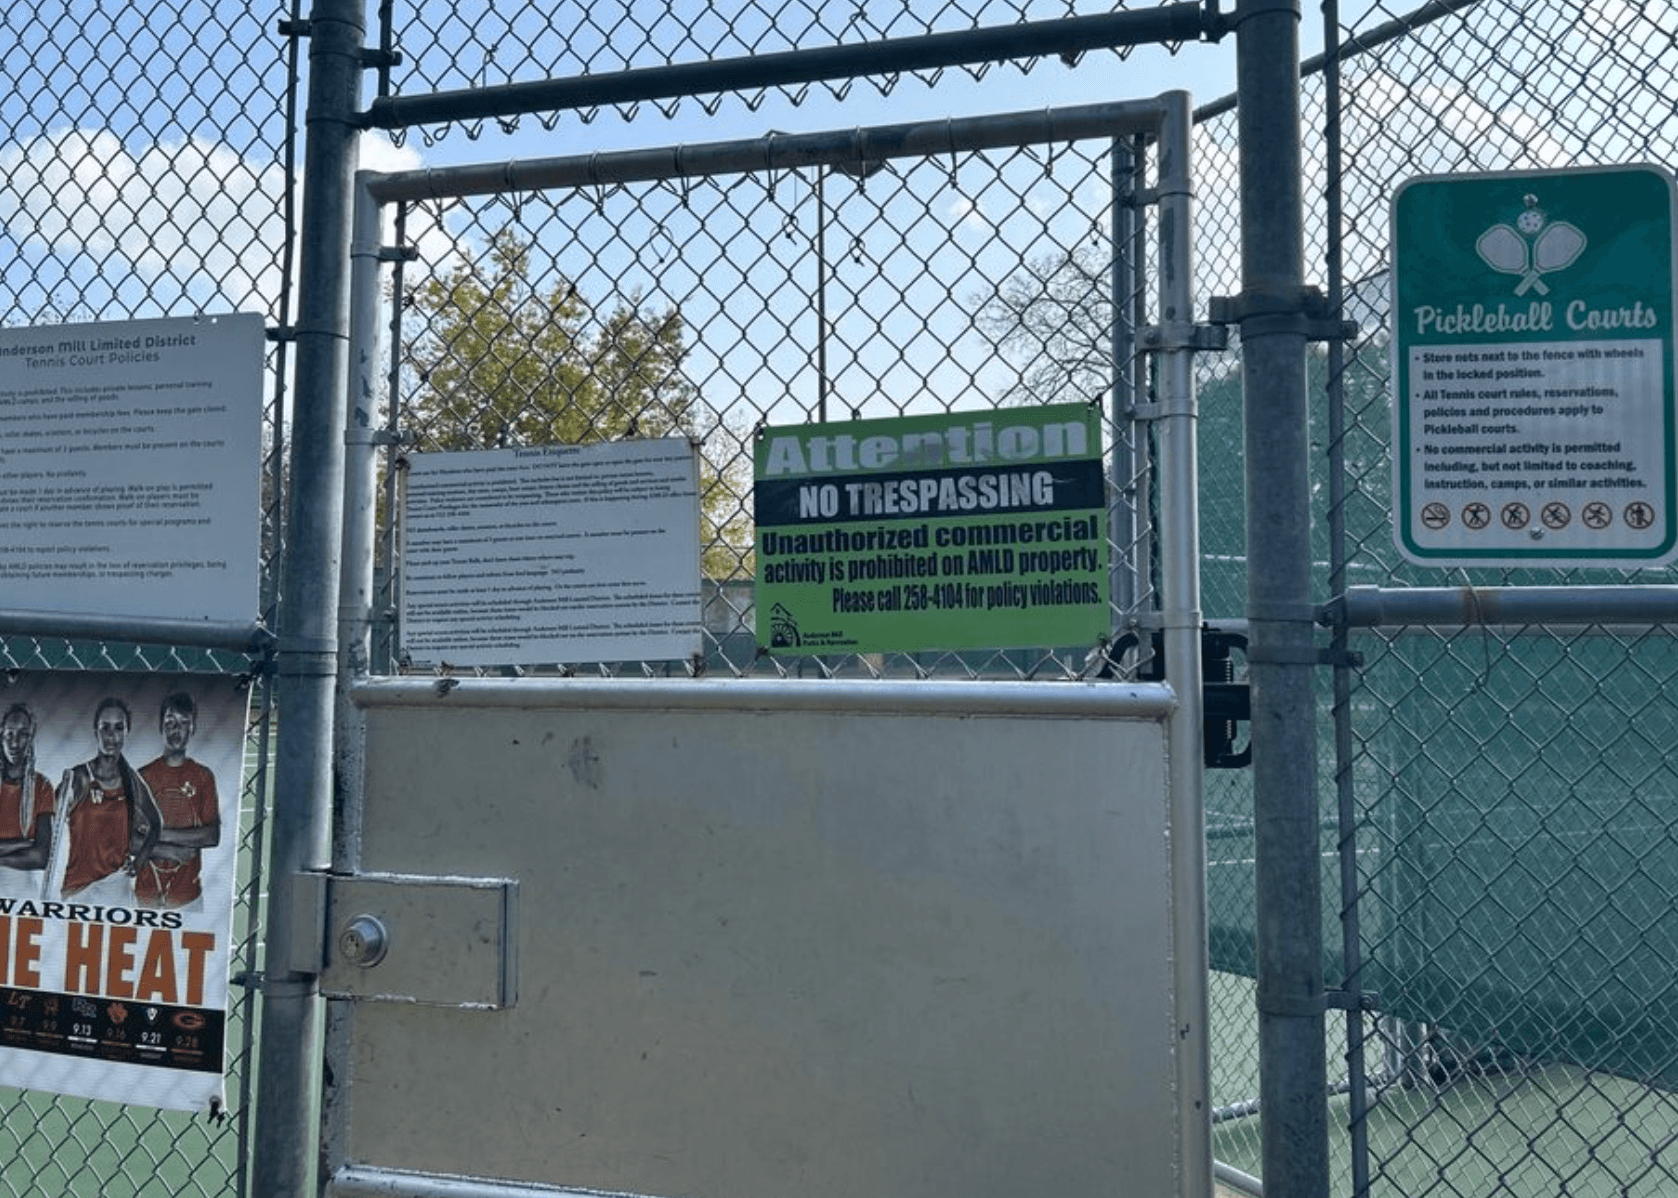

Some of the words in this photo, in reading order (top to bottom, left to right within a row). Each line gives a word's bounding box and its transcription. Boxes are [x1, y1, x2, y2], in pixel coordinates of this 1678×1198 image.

[1414, 302, 1553, 334] Pickleball
[1566, 300, 1657, 330] Courts
[0, 344, 54, 357] nderson
[58, 340, 86, 352] Mill
[90, 336, 140, 351] Limited
[145, 333, 196, 348] District
[26, 356, 66, 369] Tennis
[69, 354, 105, 366] Court
[109, 351, 160, 364] Policies
[1422, 352, 1452, 364] Store
[1455, 352, 1479, 362] nets
[1481, 351, 1505, 362] next
[1507, 351, 1519, 361] to
[1521, 350, 1540, 361] the
[1542, 349, 1575, 360] fence
[1577, 348, 1601, 359] with
[1604, 348, 1644, 359] wheels
[1436, 369, 1455, 380] the
[1456, 368, 1494, 379] locked
[1495, 367, 1545, 381] position.
[1423, 389, 1438, 399] All
[1440, 389, 1475, 399] Tennis
[1478, 389, 1507, 399] court
[1509, 388, 1541, 401] rules,
[1544, 387, 1618, 398] reservations,
[1423, 406, 1467, 419] policies
[1469, 406, 1490, 416] and
[1492, 405, 1556, 418] procedures
[1558, 404, 1589, 417] apply
[1591, 405, 1604, 415] to
[1423, 424, 1479, 435] Pickleball
[765, 421, 1088, 476] Attention
[1423, 444, 1439, 454] No
[1441, 443, 1507, 454] commercial
[1509, 442, 1549, 455] activity
[1552, 443, 1562, 453] is
[1564, 442, 1621, 455] permitted
[1481, 461, 1500, 471] but
[1502, 461, 1521, 471] not
[1523, 461, 1563, 471] limited
[1566, 461, 1578, 470] to
[1580, 460, 1637, 472] coaching,
[1491, 479, 1531, 490] camps,
[1533, 480, 1545, 488] or
[1548, 478, 1587, 488] similar
[1589, 477, 1647, 488] activities.
[800, 484, 839, 519] NO
[844, 471, 1054, 516] TRESPASSING
[762, 524, 929, 556] Unauthorized
[935, 514, 1099, 547] commercial
[764, 556, 826, 585] activity
[829, 555, 845, 581] is
[848, 552, 938, 583] prohibited
[942, 554, 964, 576] on
[967, 550, 1015, 576] AMLD
[1019, 546, 1103, 576] property.
[833, 586, 875, 614] Please
[877, 585, 903, 611] call
[904, 583, 964, 611] 258-4104
[965, 582, 985, 608] for
[987, 581, 1028, 611] policy
[1030, 579, 1103, 605] violations.
[0, 898, 183, 930] WARRIORS
[64, 920, 216, 1006] HEAT
